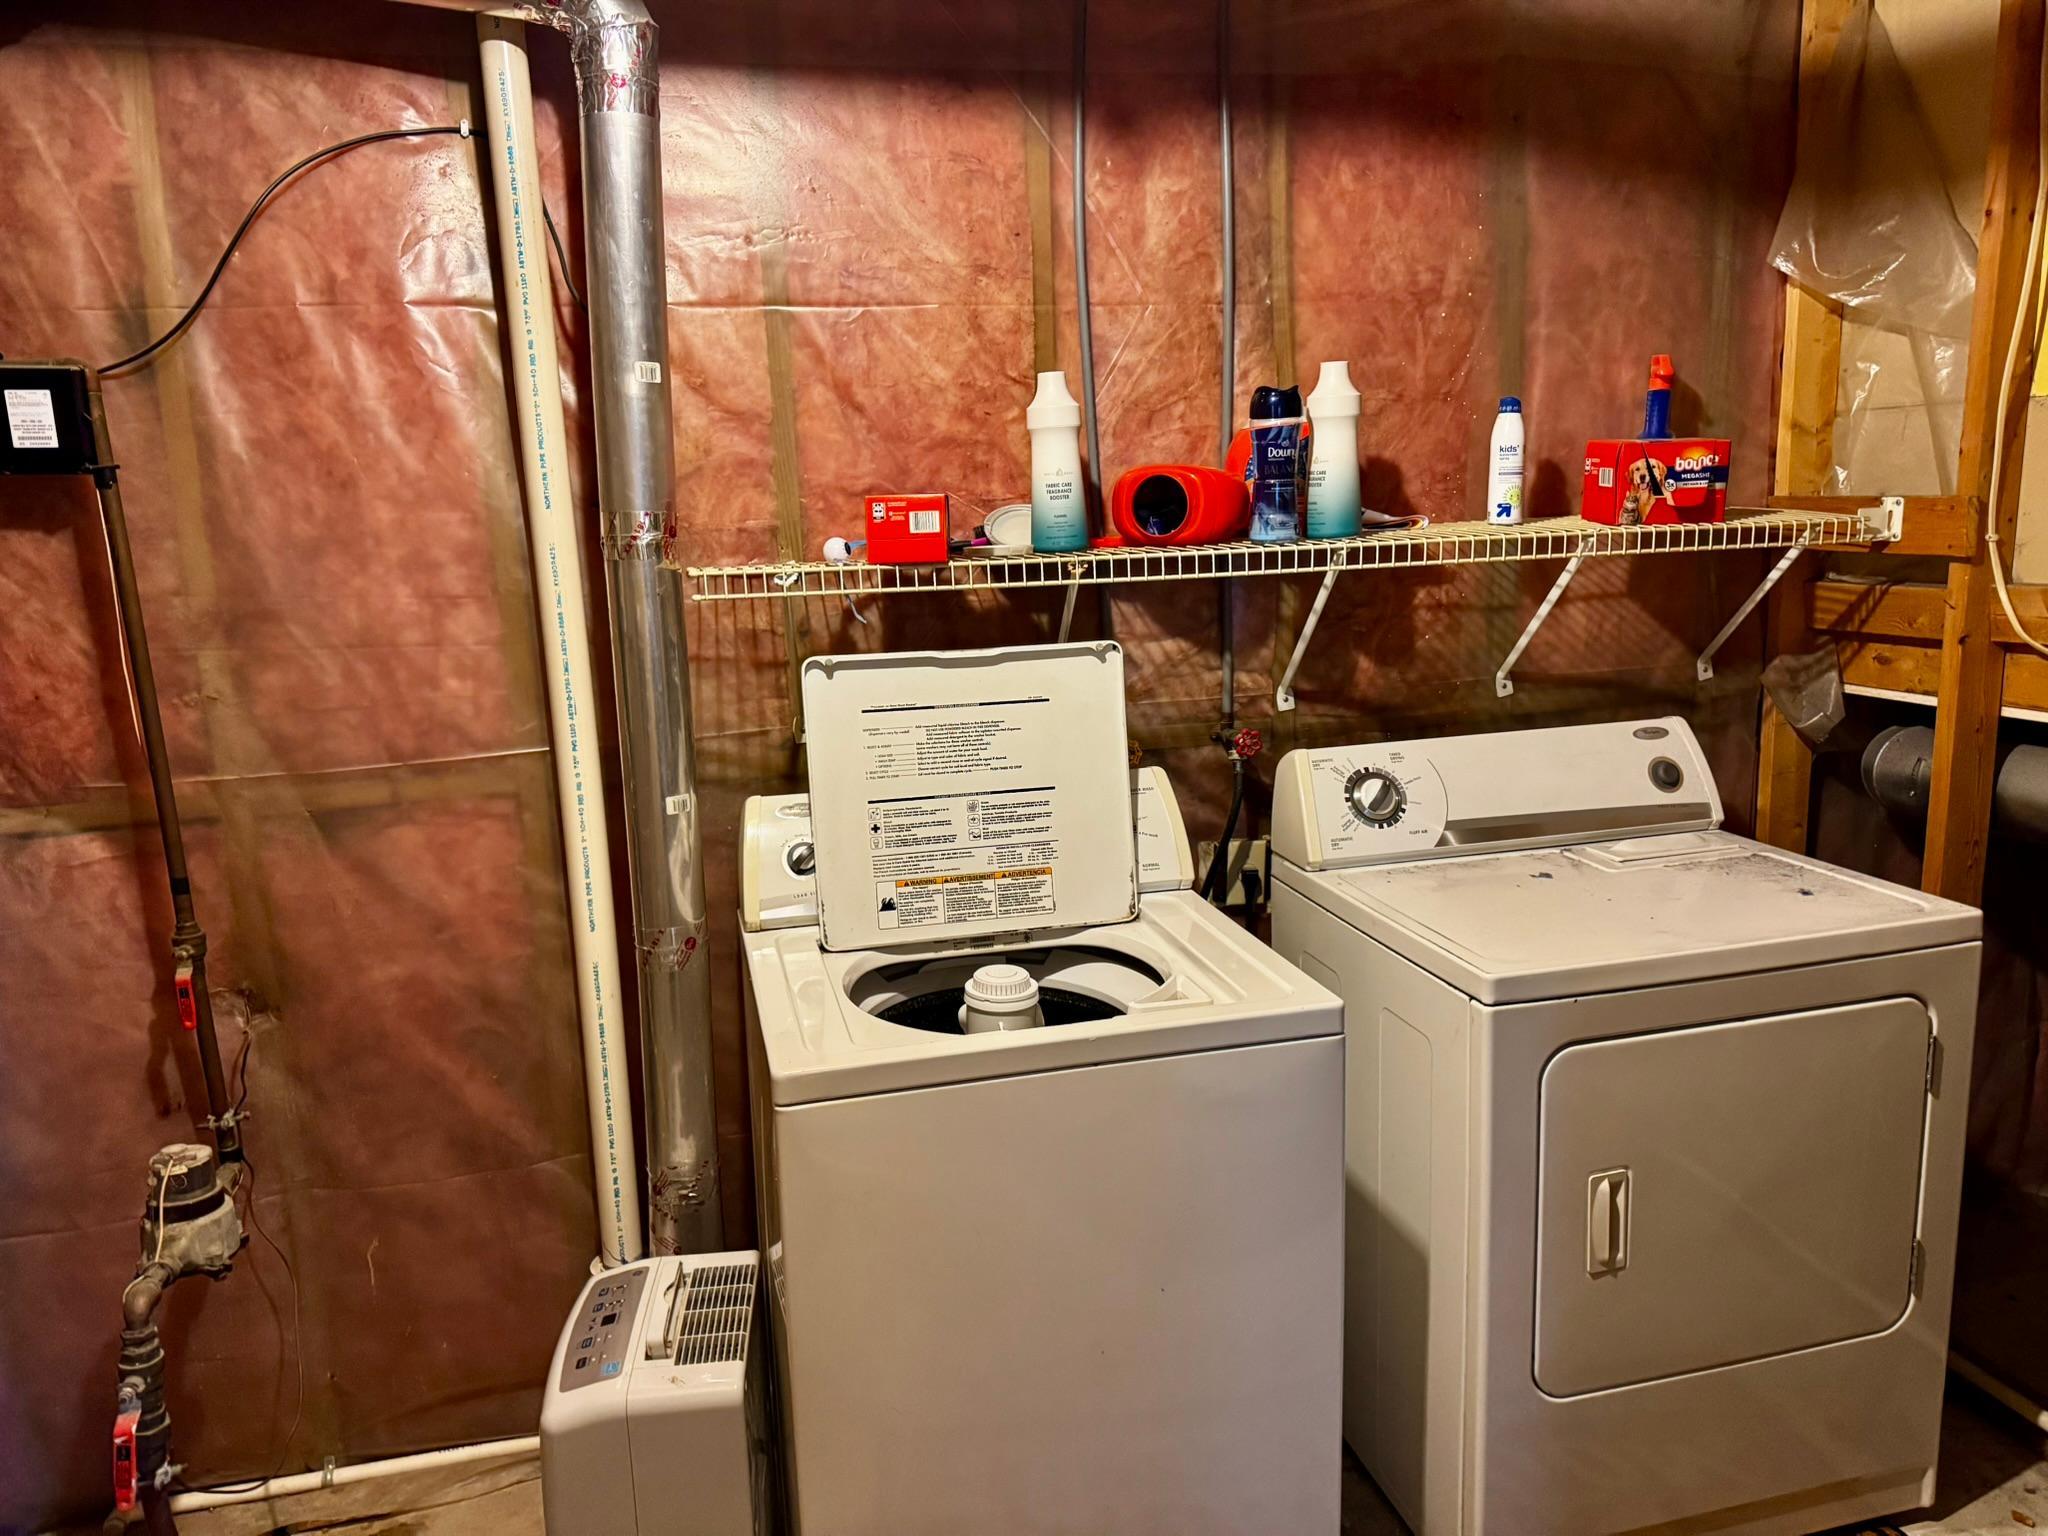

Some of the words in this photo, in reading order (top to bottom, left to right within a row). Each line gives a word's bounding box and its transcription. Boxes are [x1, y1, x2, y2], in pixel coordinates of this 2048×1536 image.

[1008, 869, 1046, 878] ADVERTENCIA
[910, 878, 936, 886] WARNING
[949, 874, 994, 883] AVERTISSEMENT
